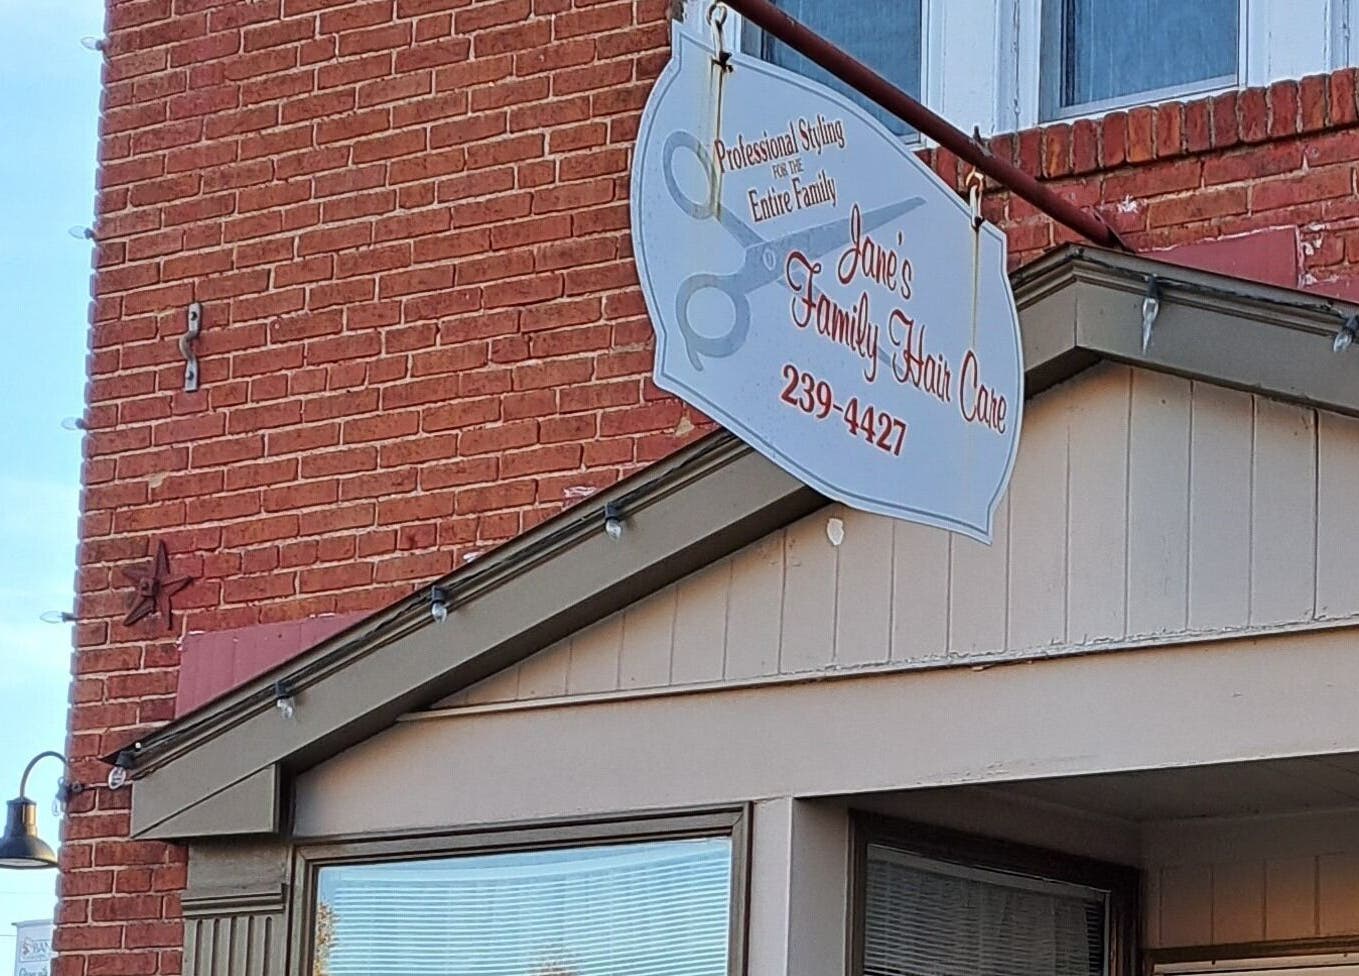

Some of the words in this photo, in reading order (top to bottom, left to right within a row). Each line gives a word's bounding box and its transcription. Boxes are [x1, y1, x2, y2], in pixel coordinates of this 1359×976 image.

[716, 128, 799, 173] Professional
[800, 117, 844, 157] Styling
[773, 163, 788, 179] FOR
[789, 158, 805, 174] THE
[749, 186, 793, 223] Entire
[795, 170, 836, 208] Family
[837, 203, 914, 300] Jane's
[785, 250, 881, 384] Family
[889, 310, 951, 404] Hair
[959, 350, 1008, 434] Care
[780, 365, 908, 457] 239-4427
